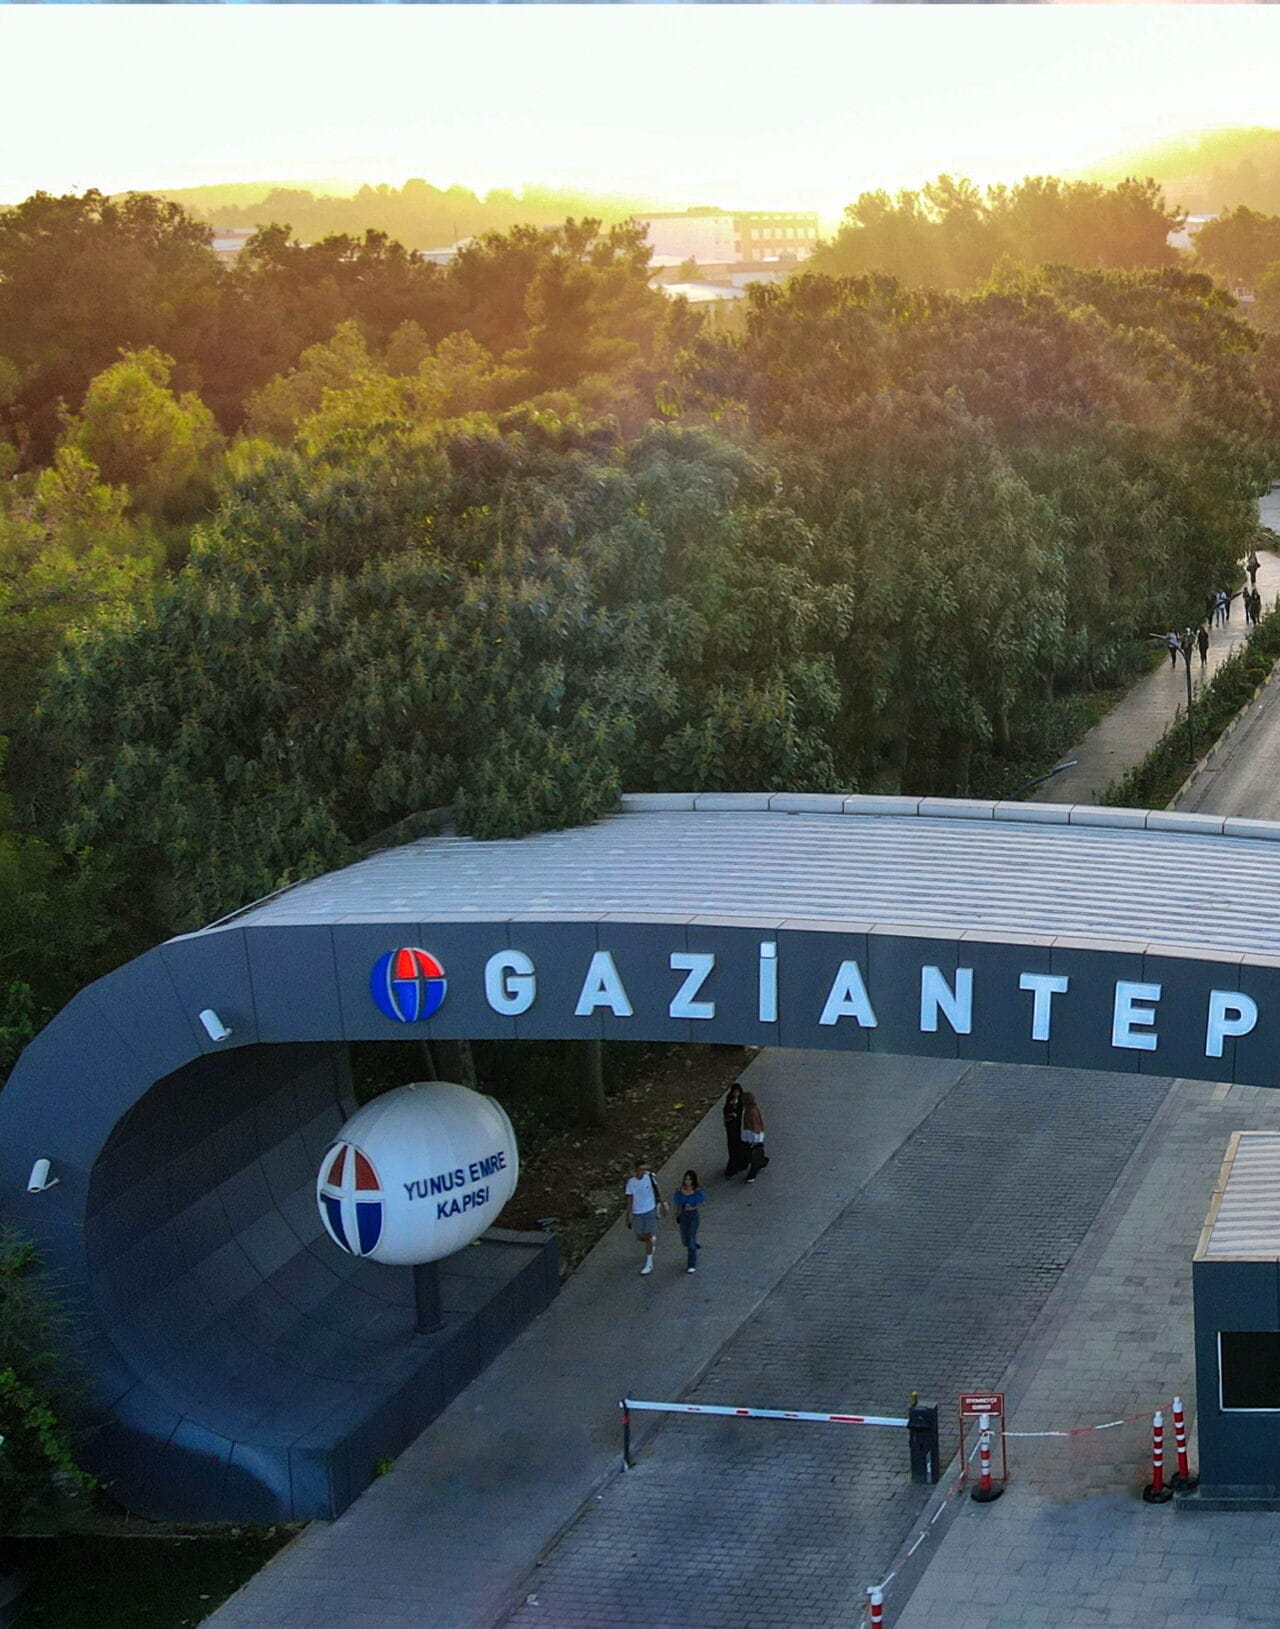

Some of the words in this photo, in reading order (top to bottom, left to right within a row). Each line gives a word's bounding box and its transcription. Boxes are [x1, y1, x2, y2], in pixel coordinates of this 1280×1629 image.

[484, 941, 1259, 1058] GAZİANTEP
[403, 1168, 466, 1201] YUNUS
[468, 1151, 507, 1182] EMRE
[436, 1186, 489, 1220] KAPISI
